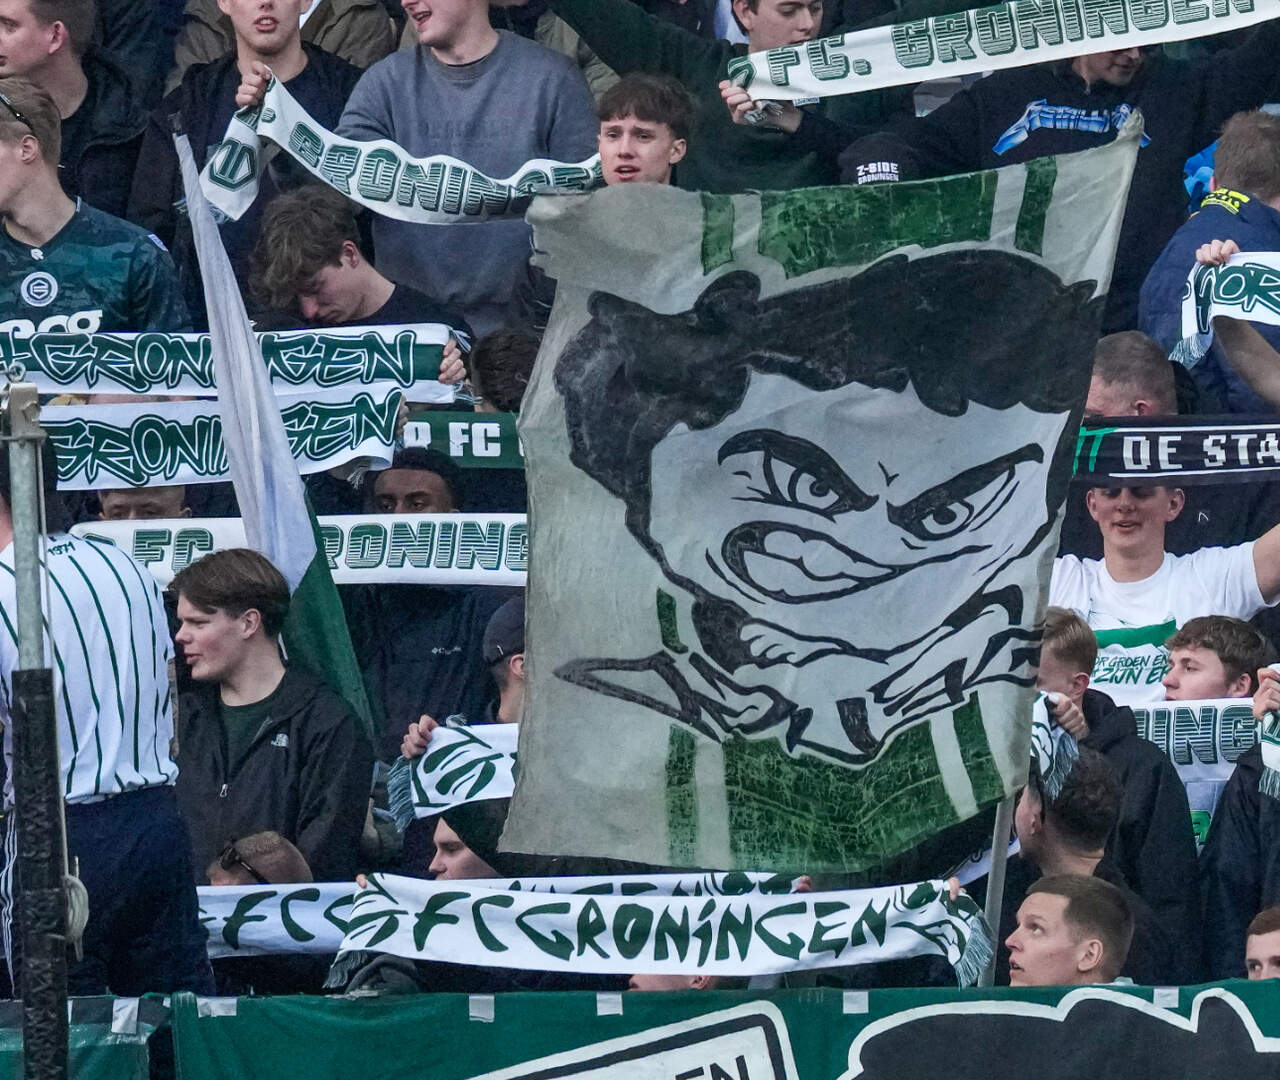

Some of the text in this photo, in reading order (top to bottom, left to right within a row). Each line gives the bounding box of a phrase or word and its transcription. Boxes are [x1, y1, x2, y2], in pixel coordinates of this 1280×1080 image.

[856, 161, 899, 177] Z-SIDE
[30, 330, 416, 394] GRONGEN
[448, 421, 502, 458] FC
[1122, 434, 1184, 471] DE
[132, 528, 214, 572] FC
[1108, 655, 1149, 668] GROEN
